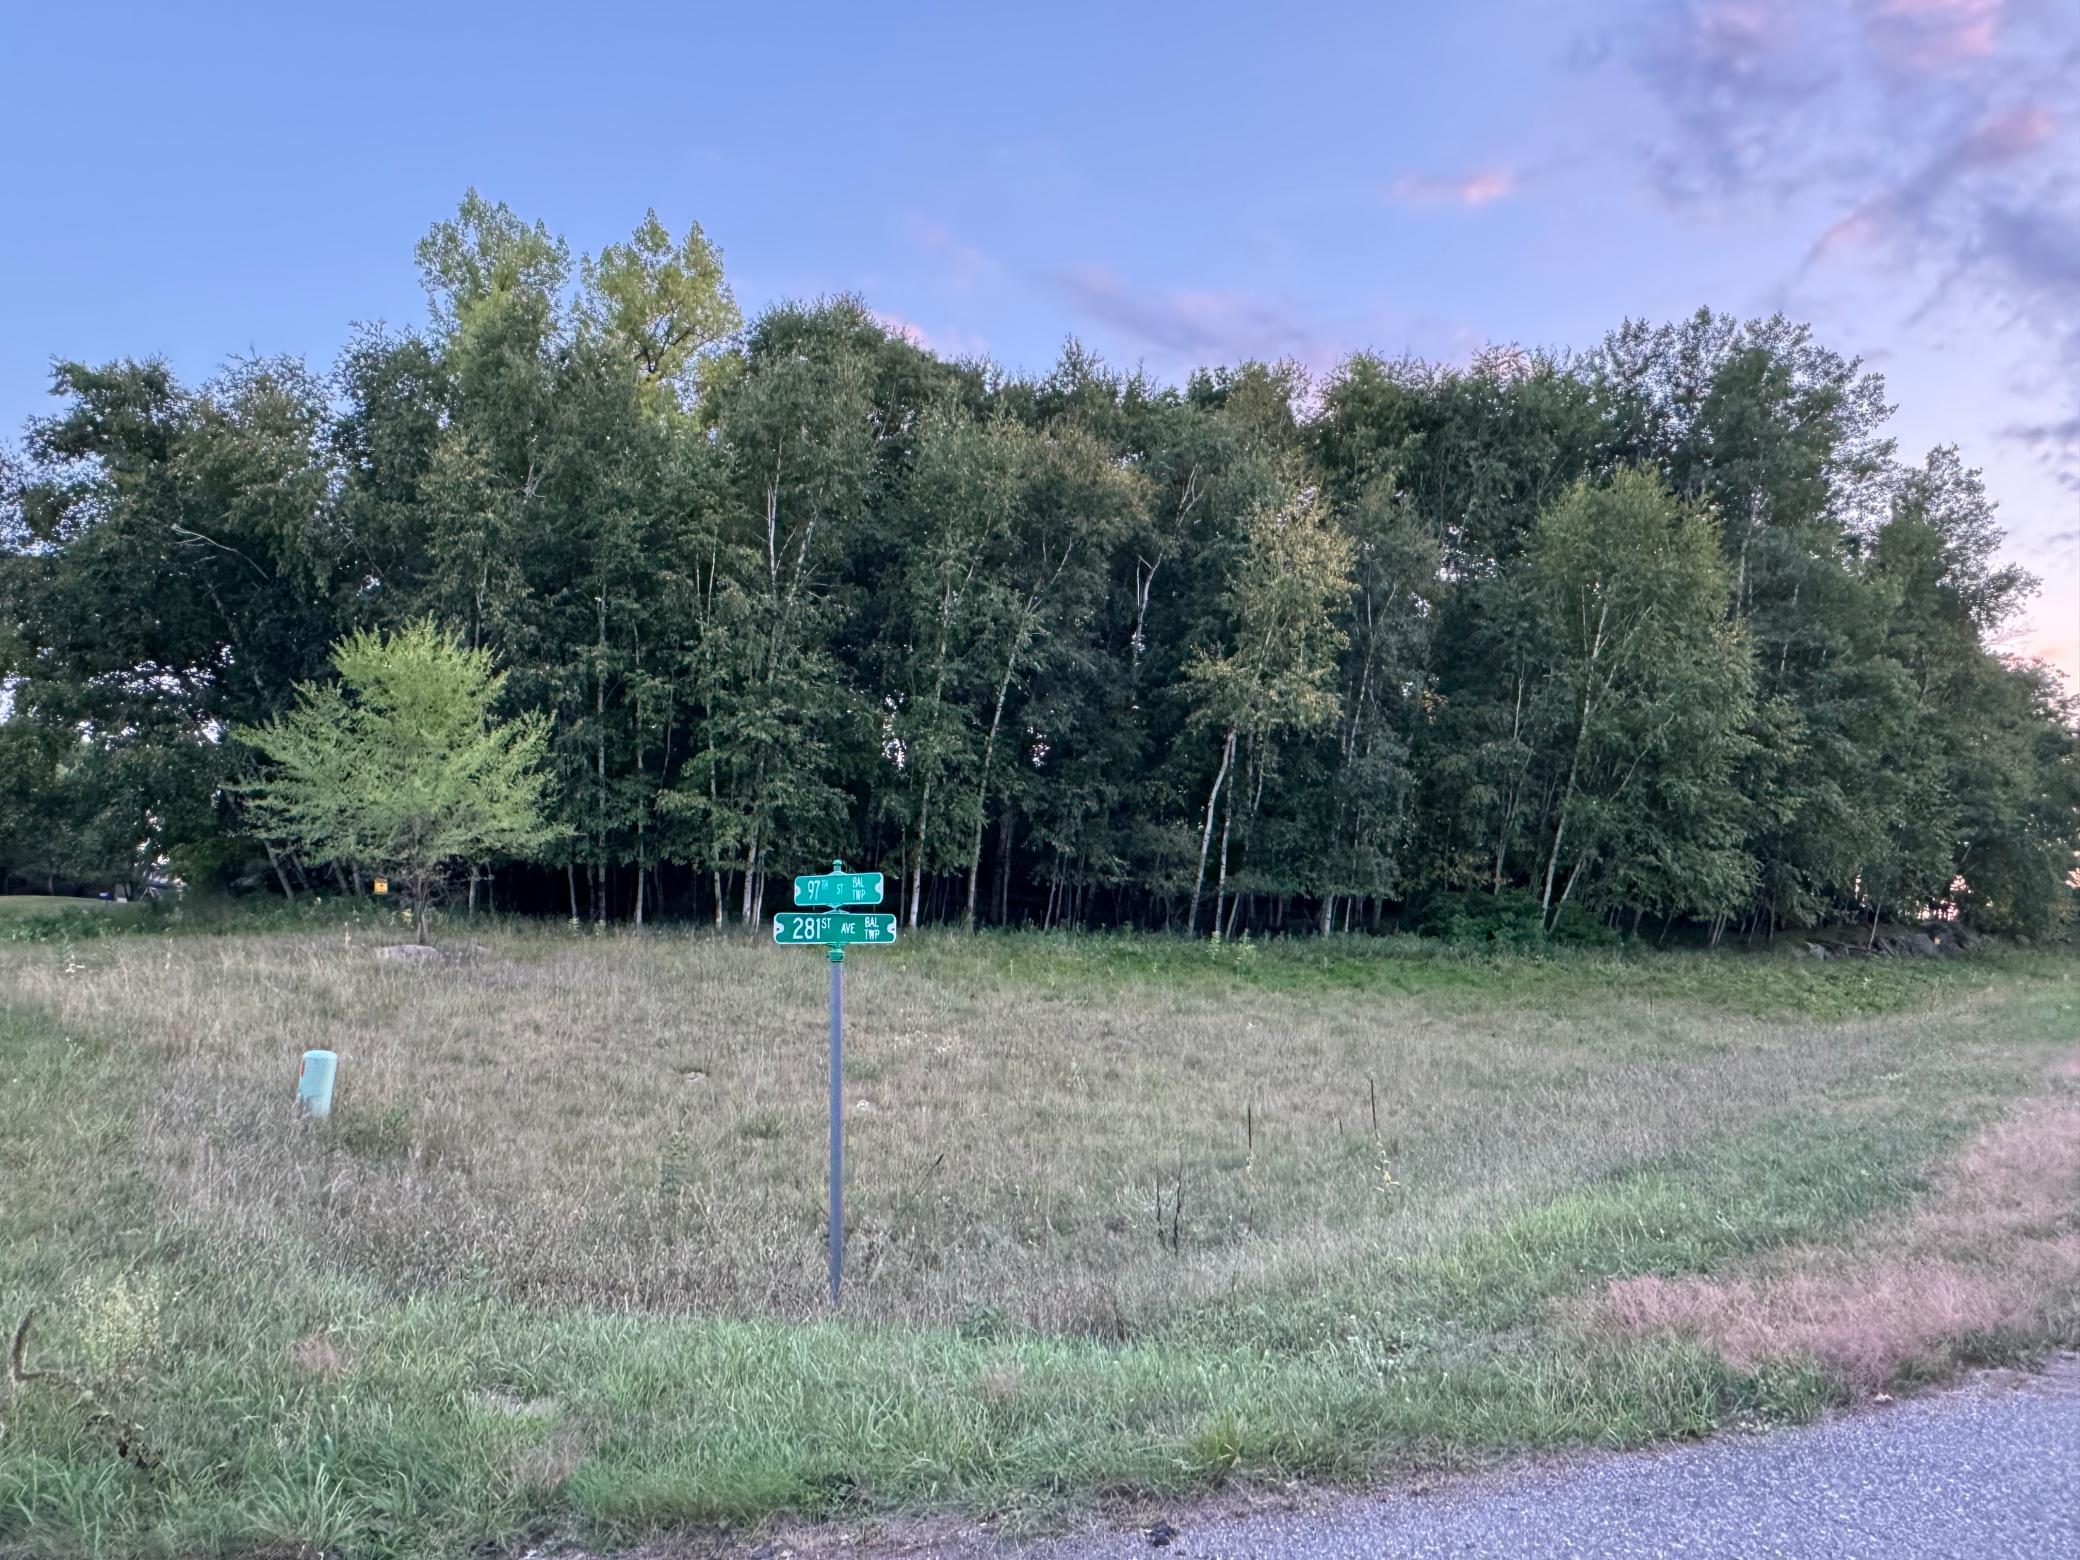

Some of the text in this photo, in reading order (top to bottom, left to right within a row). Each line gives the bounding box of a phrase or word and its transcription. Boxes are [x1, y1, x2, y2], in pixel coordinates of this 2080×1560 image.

[852, 877, 865, 888] BAL
[836, 884, 844, 895] ST
[852, 889, 866, 901] TWP
[864, 916, 879, 928] BAL
[841, 922, 856, 934] AVE
[864, 929, 880, 940] TWP
